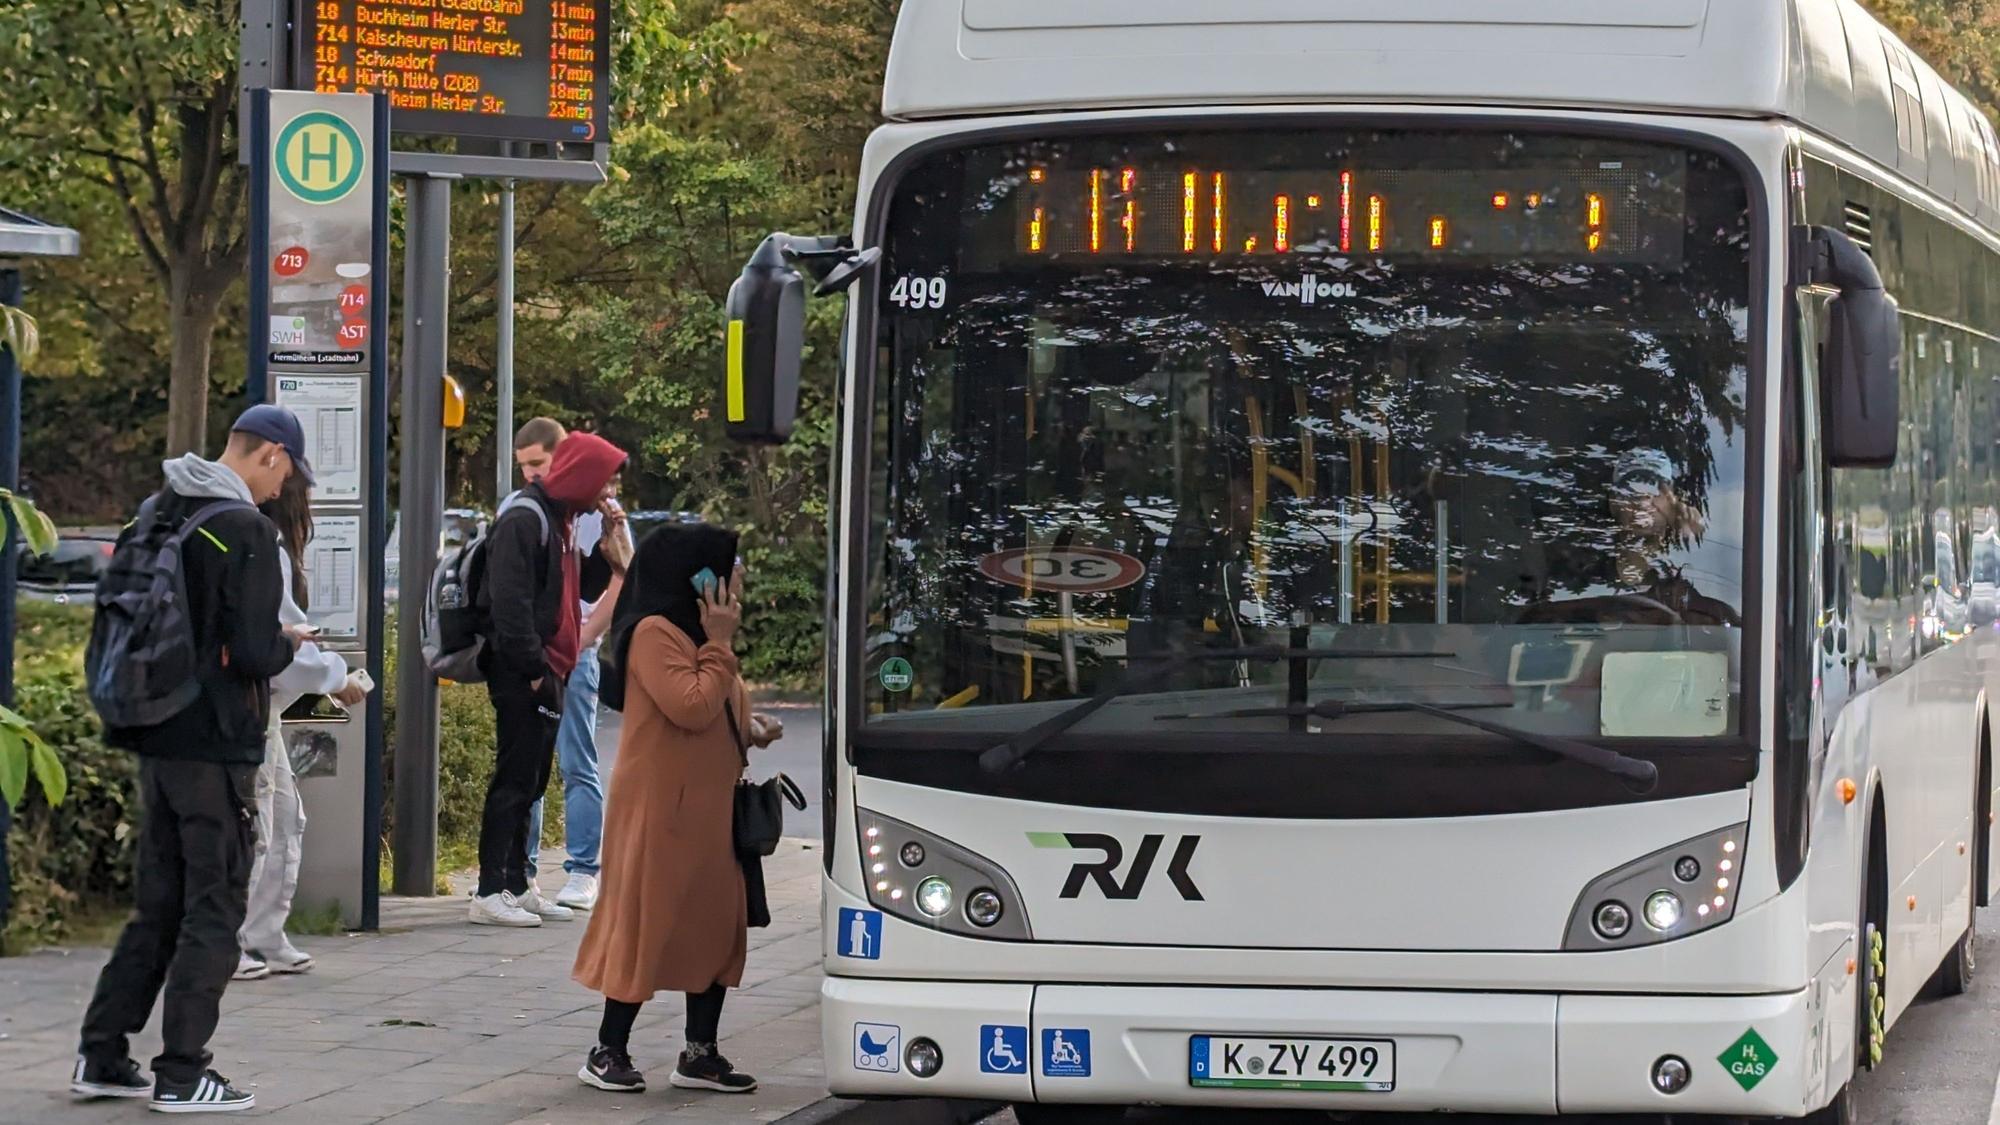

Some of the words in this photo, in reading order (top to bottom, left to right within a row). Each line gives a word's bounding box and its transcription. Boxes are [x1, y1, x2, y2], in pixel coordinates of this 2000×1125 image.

[316, 3, 339, 20] 18
[357, 6, 429, 27] Buchheim
[433, 11, 479, 31] Herler
[482, 16, 507, 35] Str.
[316, 24, 349, 42] 714
[356, 27, 448, 50] Kalscheuren
[316, 46, 338, 63] 18
[356, 48, 437, 73] Schwadorf
[316, 65, 349, 83] 714
[356, 67, 399, 87] Hürth
[403, 71, 439, 90] Mitte
[431, 92, 477, 112] Herler
[481, 96, 506, 114] Str.
[302, 131, 337, 182] H
[281, 254, 302, 268] 713
[340, 294, 364, 306] 714
[889, 276, 946, 309] 499
[271, 331, 303, 343] SWH
[340, 325, 366, 338] AST
[282, 381, 295, 390] 720
[1058, 832, 1206, 902] RVK
[1196, 1062, 1205, 1072] D
[1223, 1043, 1245, 1075] K
[1267, 1044, 1310, 1076] ZY
[1317, 1045, 1379, 1078] 499
[1731, 1061, 1766, 1076] GAS
